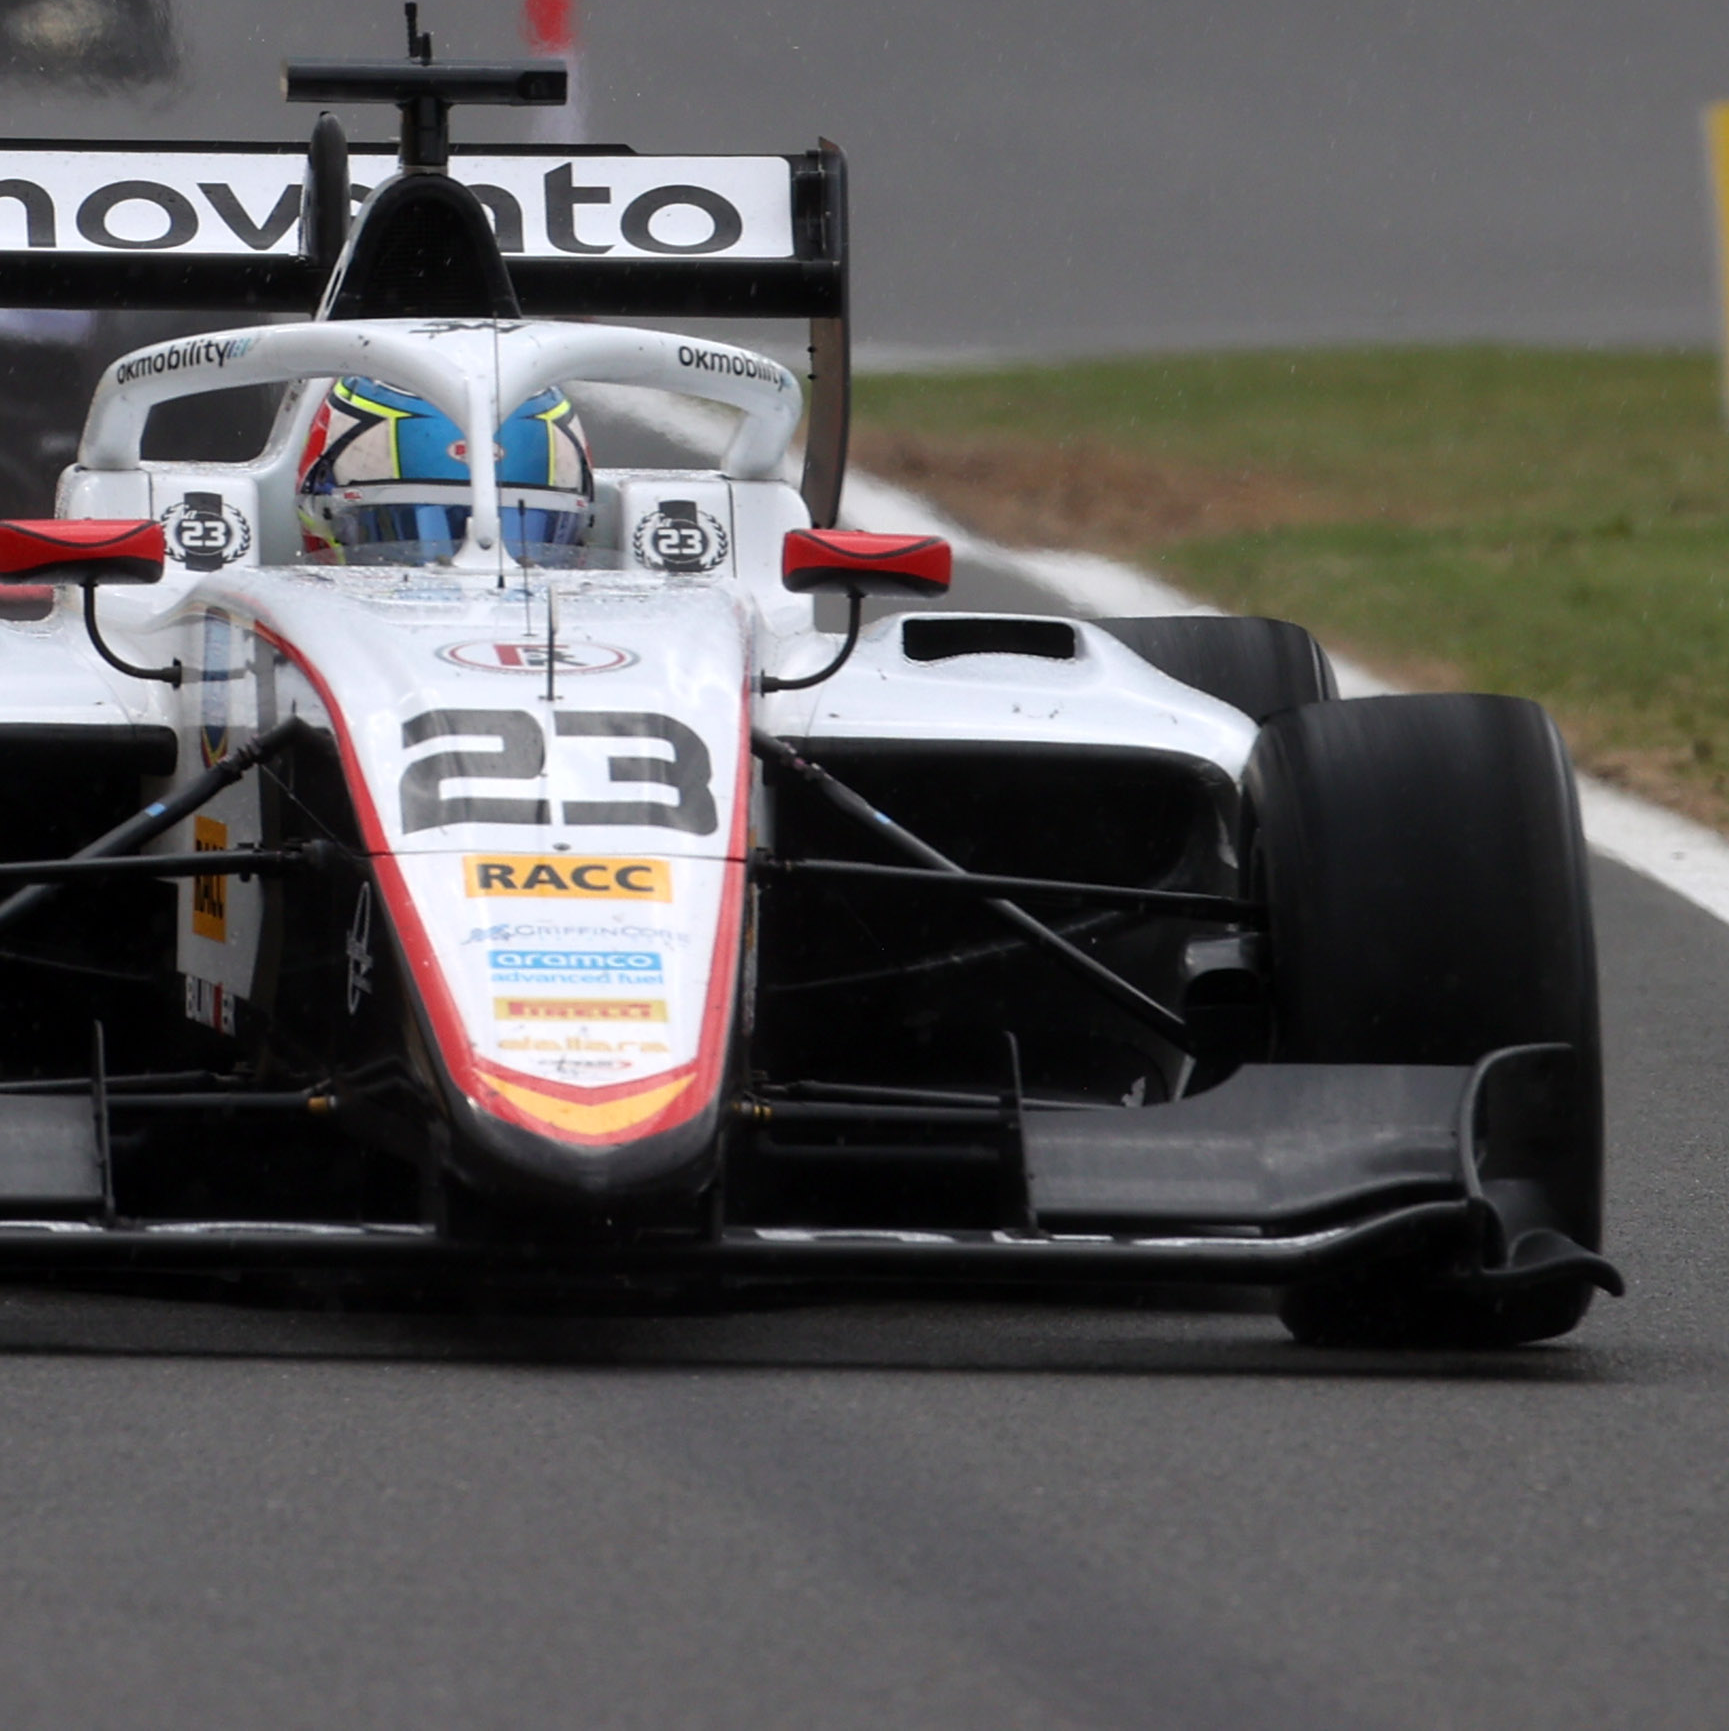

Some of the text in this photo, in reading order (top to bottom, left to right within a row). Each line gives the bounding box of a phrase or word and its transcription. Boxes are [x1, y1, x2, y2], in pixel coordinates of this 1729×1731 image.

[181, 520, 227, 547] 23
[657, 528, 704, 555] 23
[401, 708, 718, 836] 23
[476, 863, 656, 893] RACC
[496, 951, 654, 969] aramco
[491, 970, 664, 986] advanced fuel
